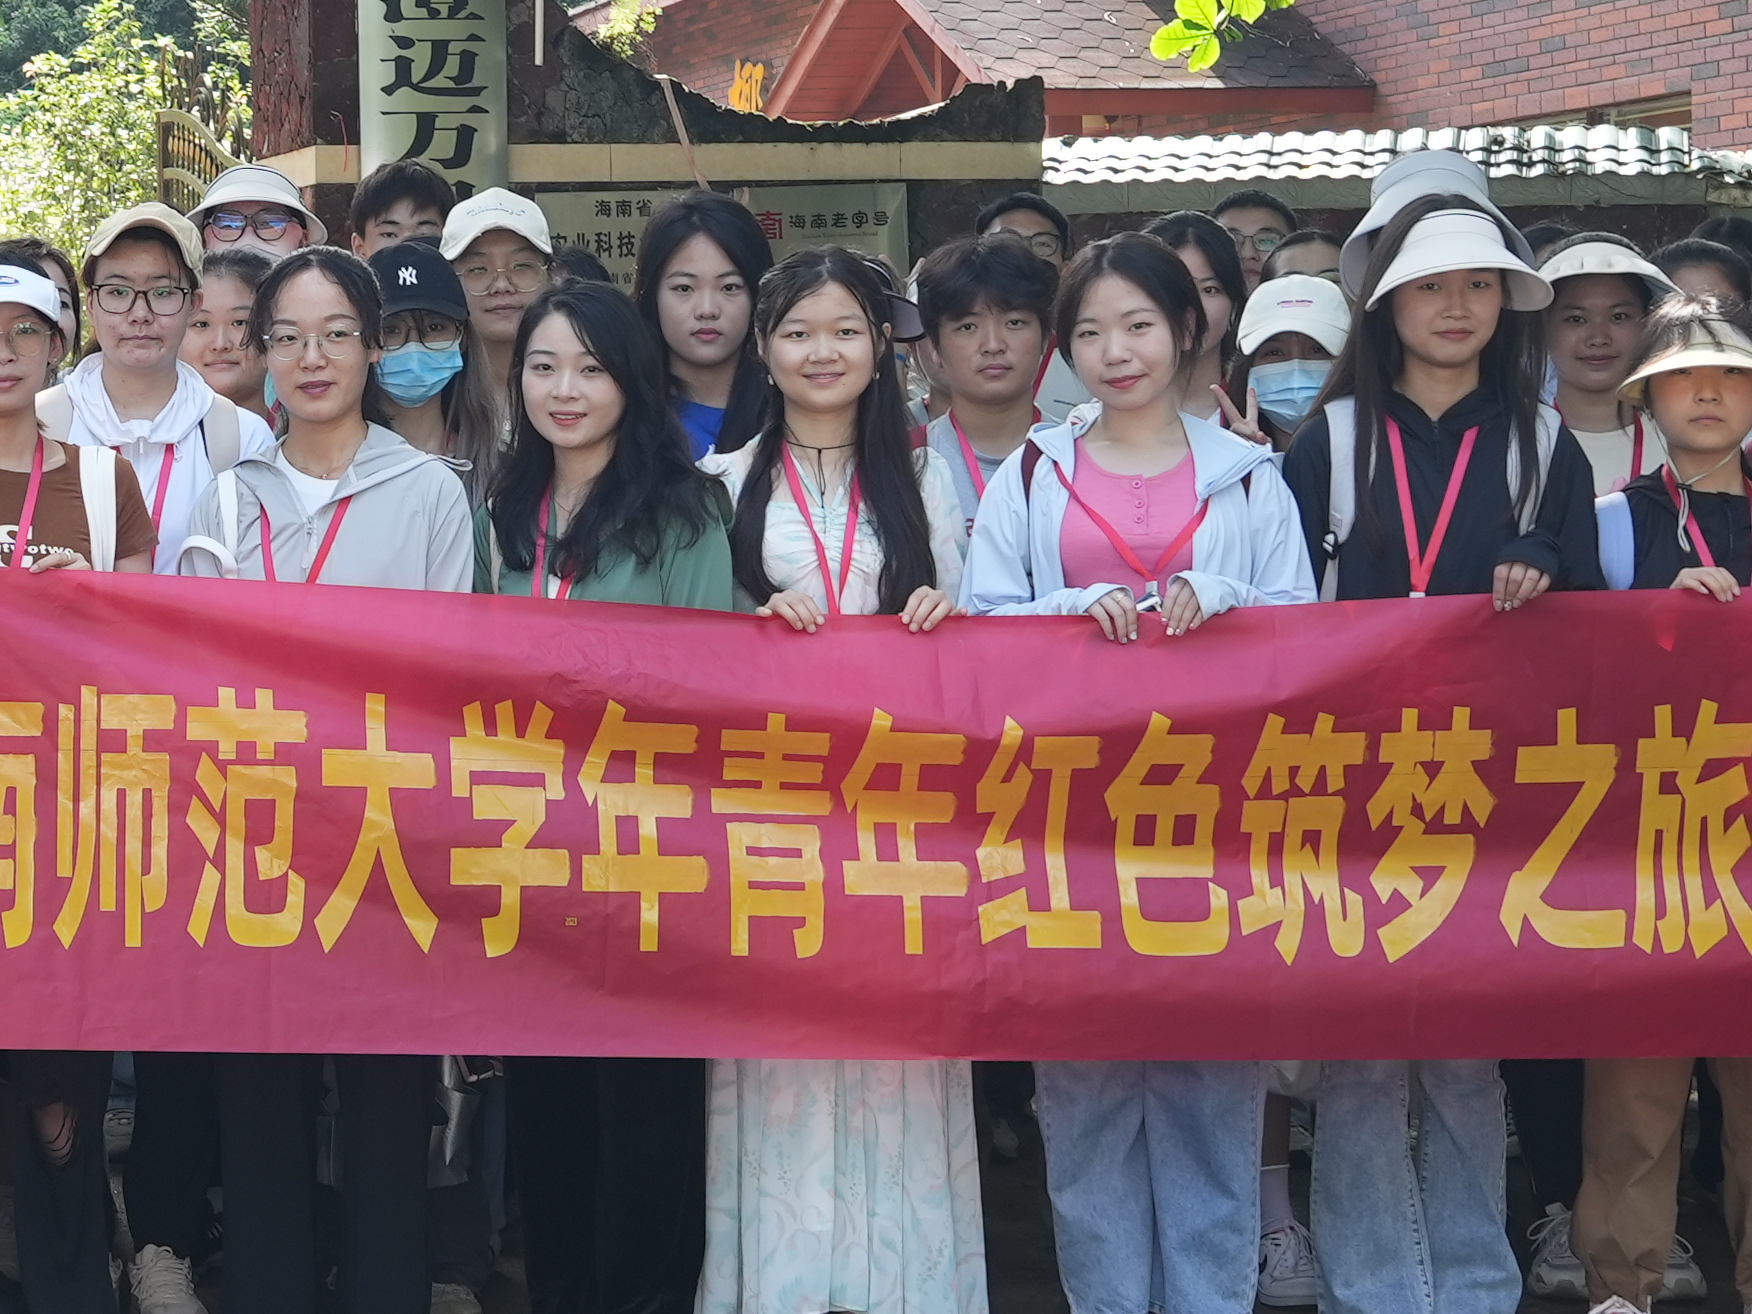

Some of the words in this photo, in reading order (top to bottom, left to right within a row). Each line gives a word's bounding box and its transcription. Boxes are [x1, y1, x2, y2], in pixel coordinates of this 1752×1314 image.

[594, 199, 652, 218] 海南省
[788, 210, 890, 230] 海南老字号
